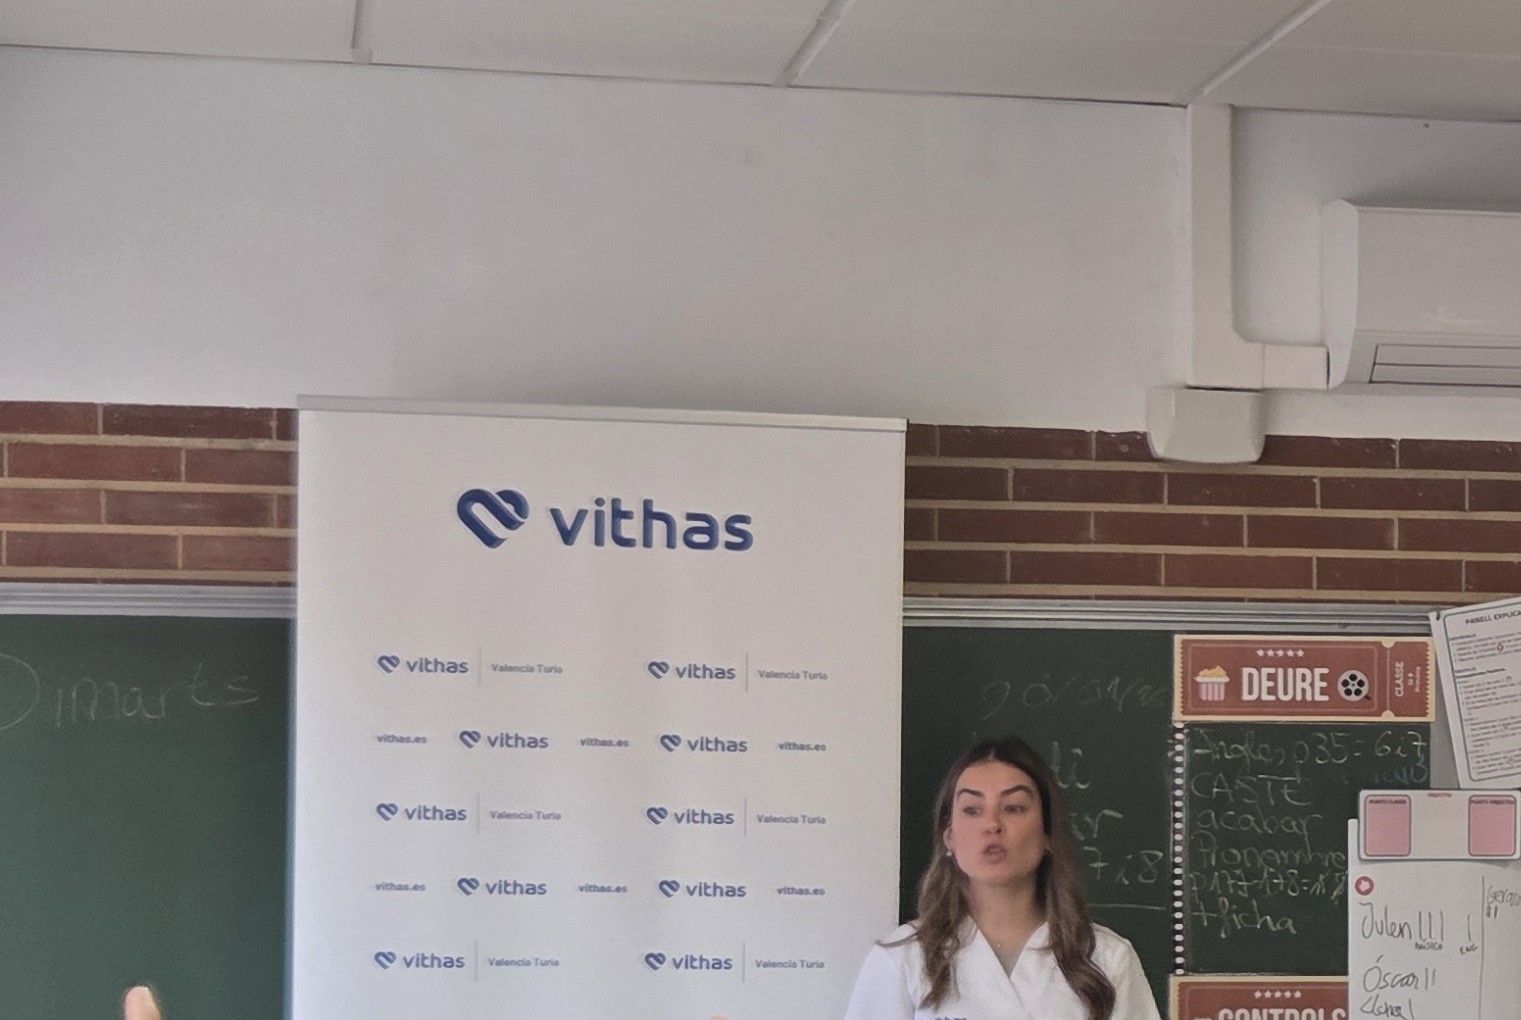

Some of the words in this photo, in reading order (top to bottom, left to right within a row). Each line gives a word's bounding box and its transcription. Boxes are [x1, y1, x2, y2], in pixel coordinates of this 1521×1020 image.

[549, 497, 754, 552] vithas
[405, 657, 470, 674] vithas
[675, 663, 737, 680] vithas
[1241, 667, 1330, 702] DEURE
[1394, 661, 1405, 698] CLASSE
[375, 733, 428, 744] vithas.es
[486, 732, 549, 749] vithas
[579, 737, 630, 748] vithas.es
[686, 735, 748, 753] vithas
[777, 741, 827, 752] vithas.es
[404, 804, 468, 822] vithas
[673, 808, 735, 825] vithas
[374, 881, 427, 892] vithas.es
[484, 879, 548, 896] vithas
[578, 883, 629, 894] vithas.es
[685, 881, 747, 898] vithas
[776, 885, 826, 896] vithas.es
[402, 952, 466, 969] vithas
[671, 954, 733, 971] vithas
